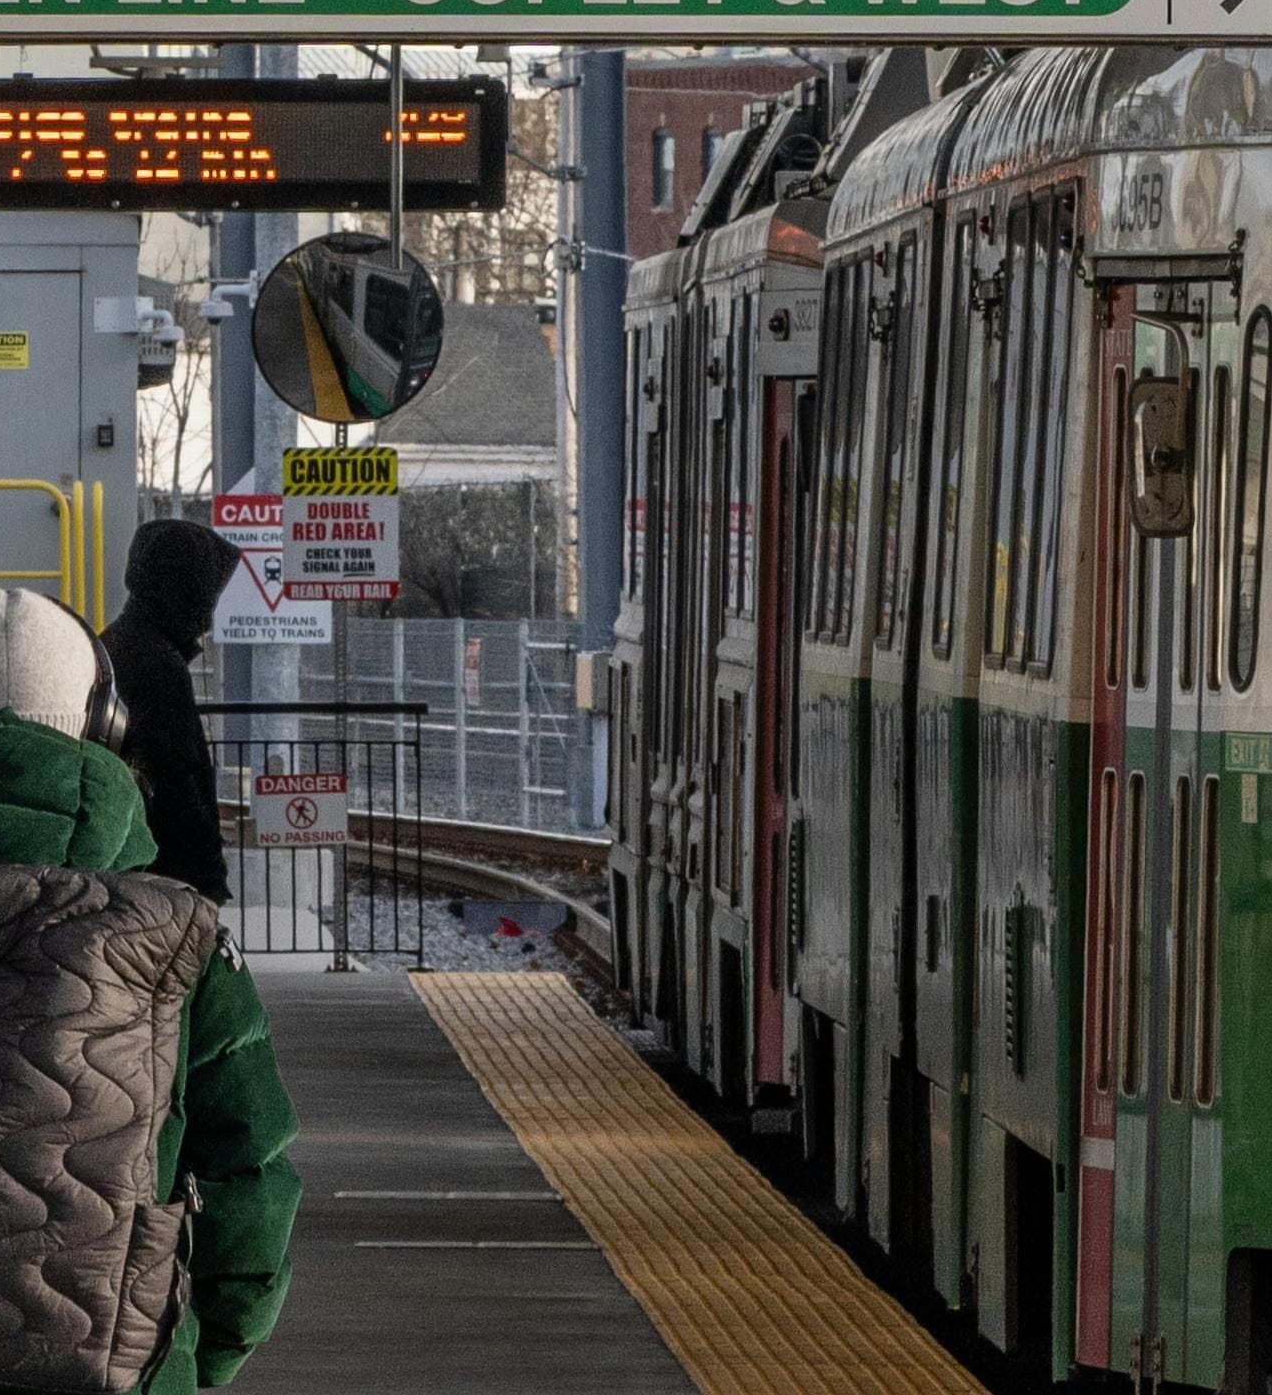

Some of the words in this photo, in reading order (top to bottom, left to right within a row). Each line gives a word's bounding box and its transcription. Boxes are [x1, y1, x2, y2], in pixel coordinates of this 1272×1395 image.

[290, 457, 391, 484] CAUTION
[221, 503, 284, 522] CAUT
[307, 502, 370, 520] DOUBLE
[292, 522, 327, 541] RED
[306, 548, 342, 559] CHECK
[344, 548, 372, 559] YOUR
[302, 561, 341, 573] SIGNAL
[343, 561, 375, 574] AGAIN
[290, 584, 324, 598] READ
[229, 616, 317, 626] PEDESTRIANS
[222, 628, 257, 638] YIELD
[281, 628, 325, 638] TRAINS
[260, 775, 342, 793] DANGER
[259, 832, 281, 844] NO
[285, 830, 346, 843] PASSING
